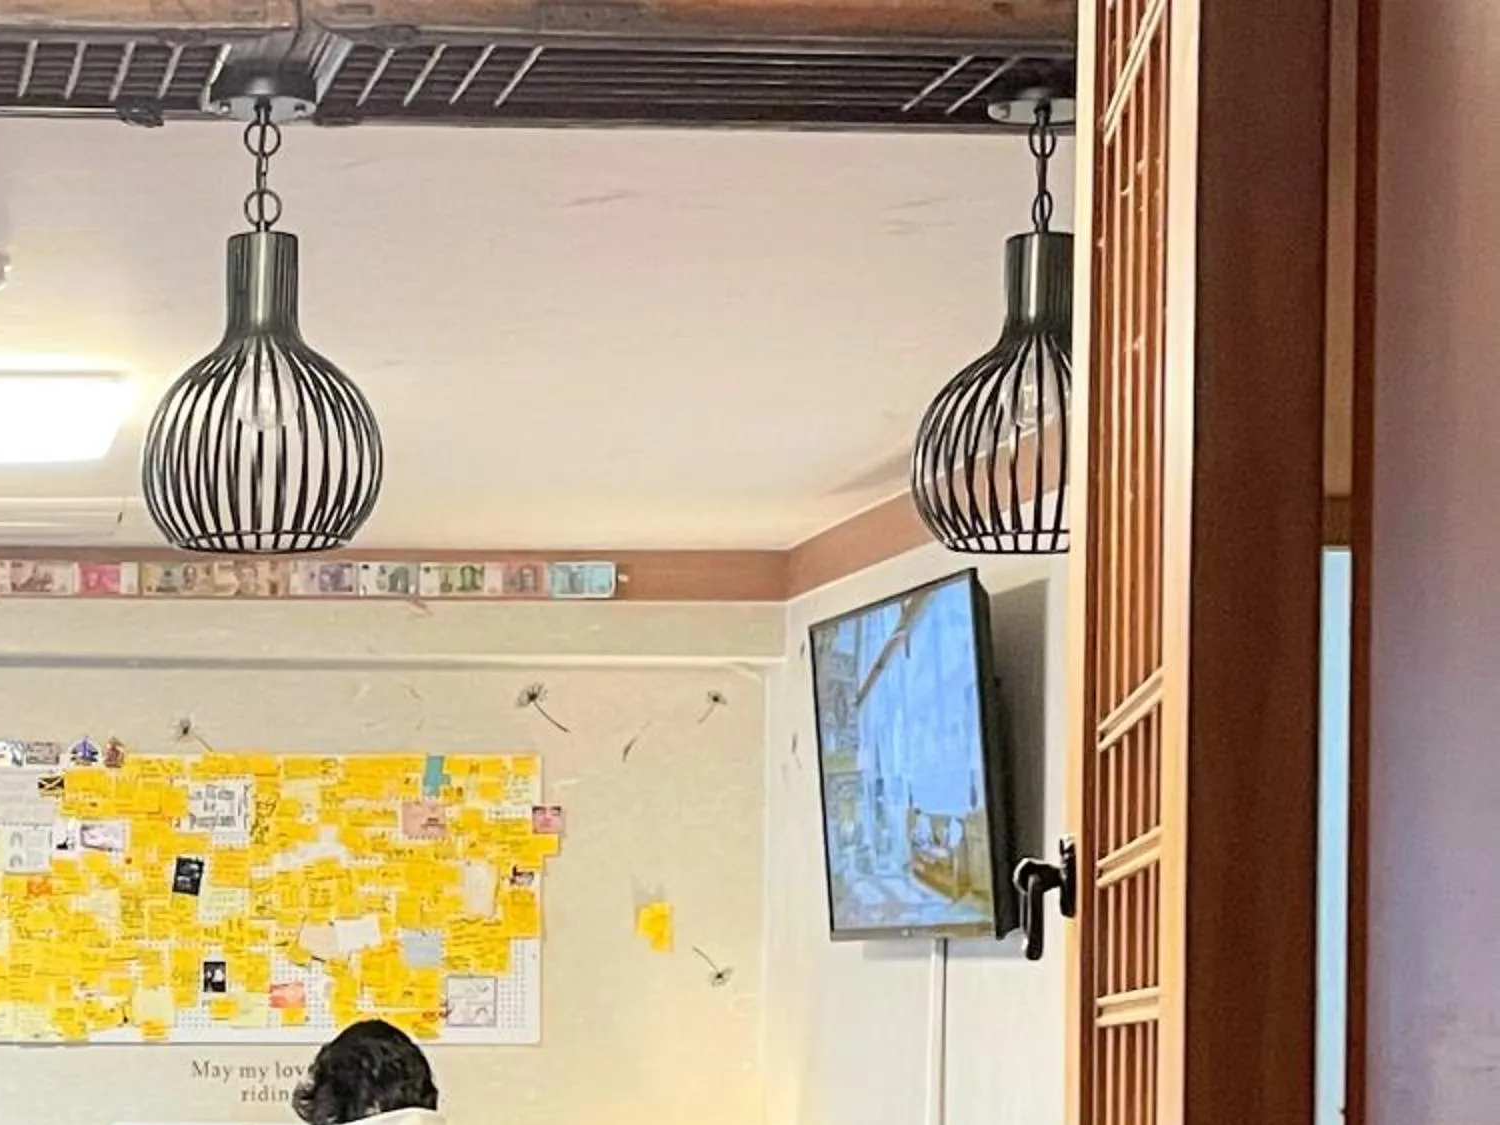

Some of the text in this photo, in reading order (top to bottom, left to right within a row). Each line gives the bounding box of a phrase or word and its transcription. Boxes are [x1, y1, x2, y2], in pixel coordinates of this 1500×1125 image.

[192, 1060, 306, 1084] May my lov
[241, 1084, 289, 1102] ridin
